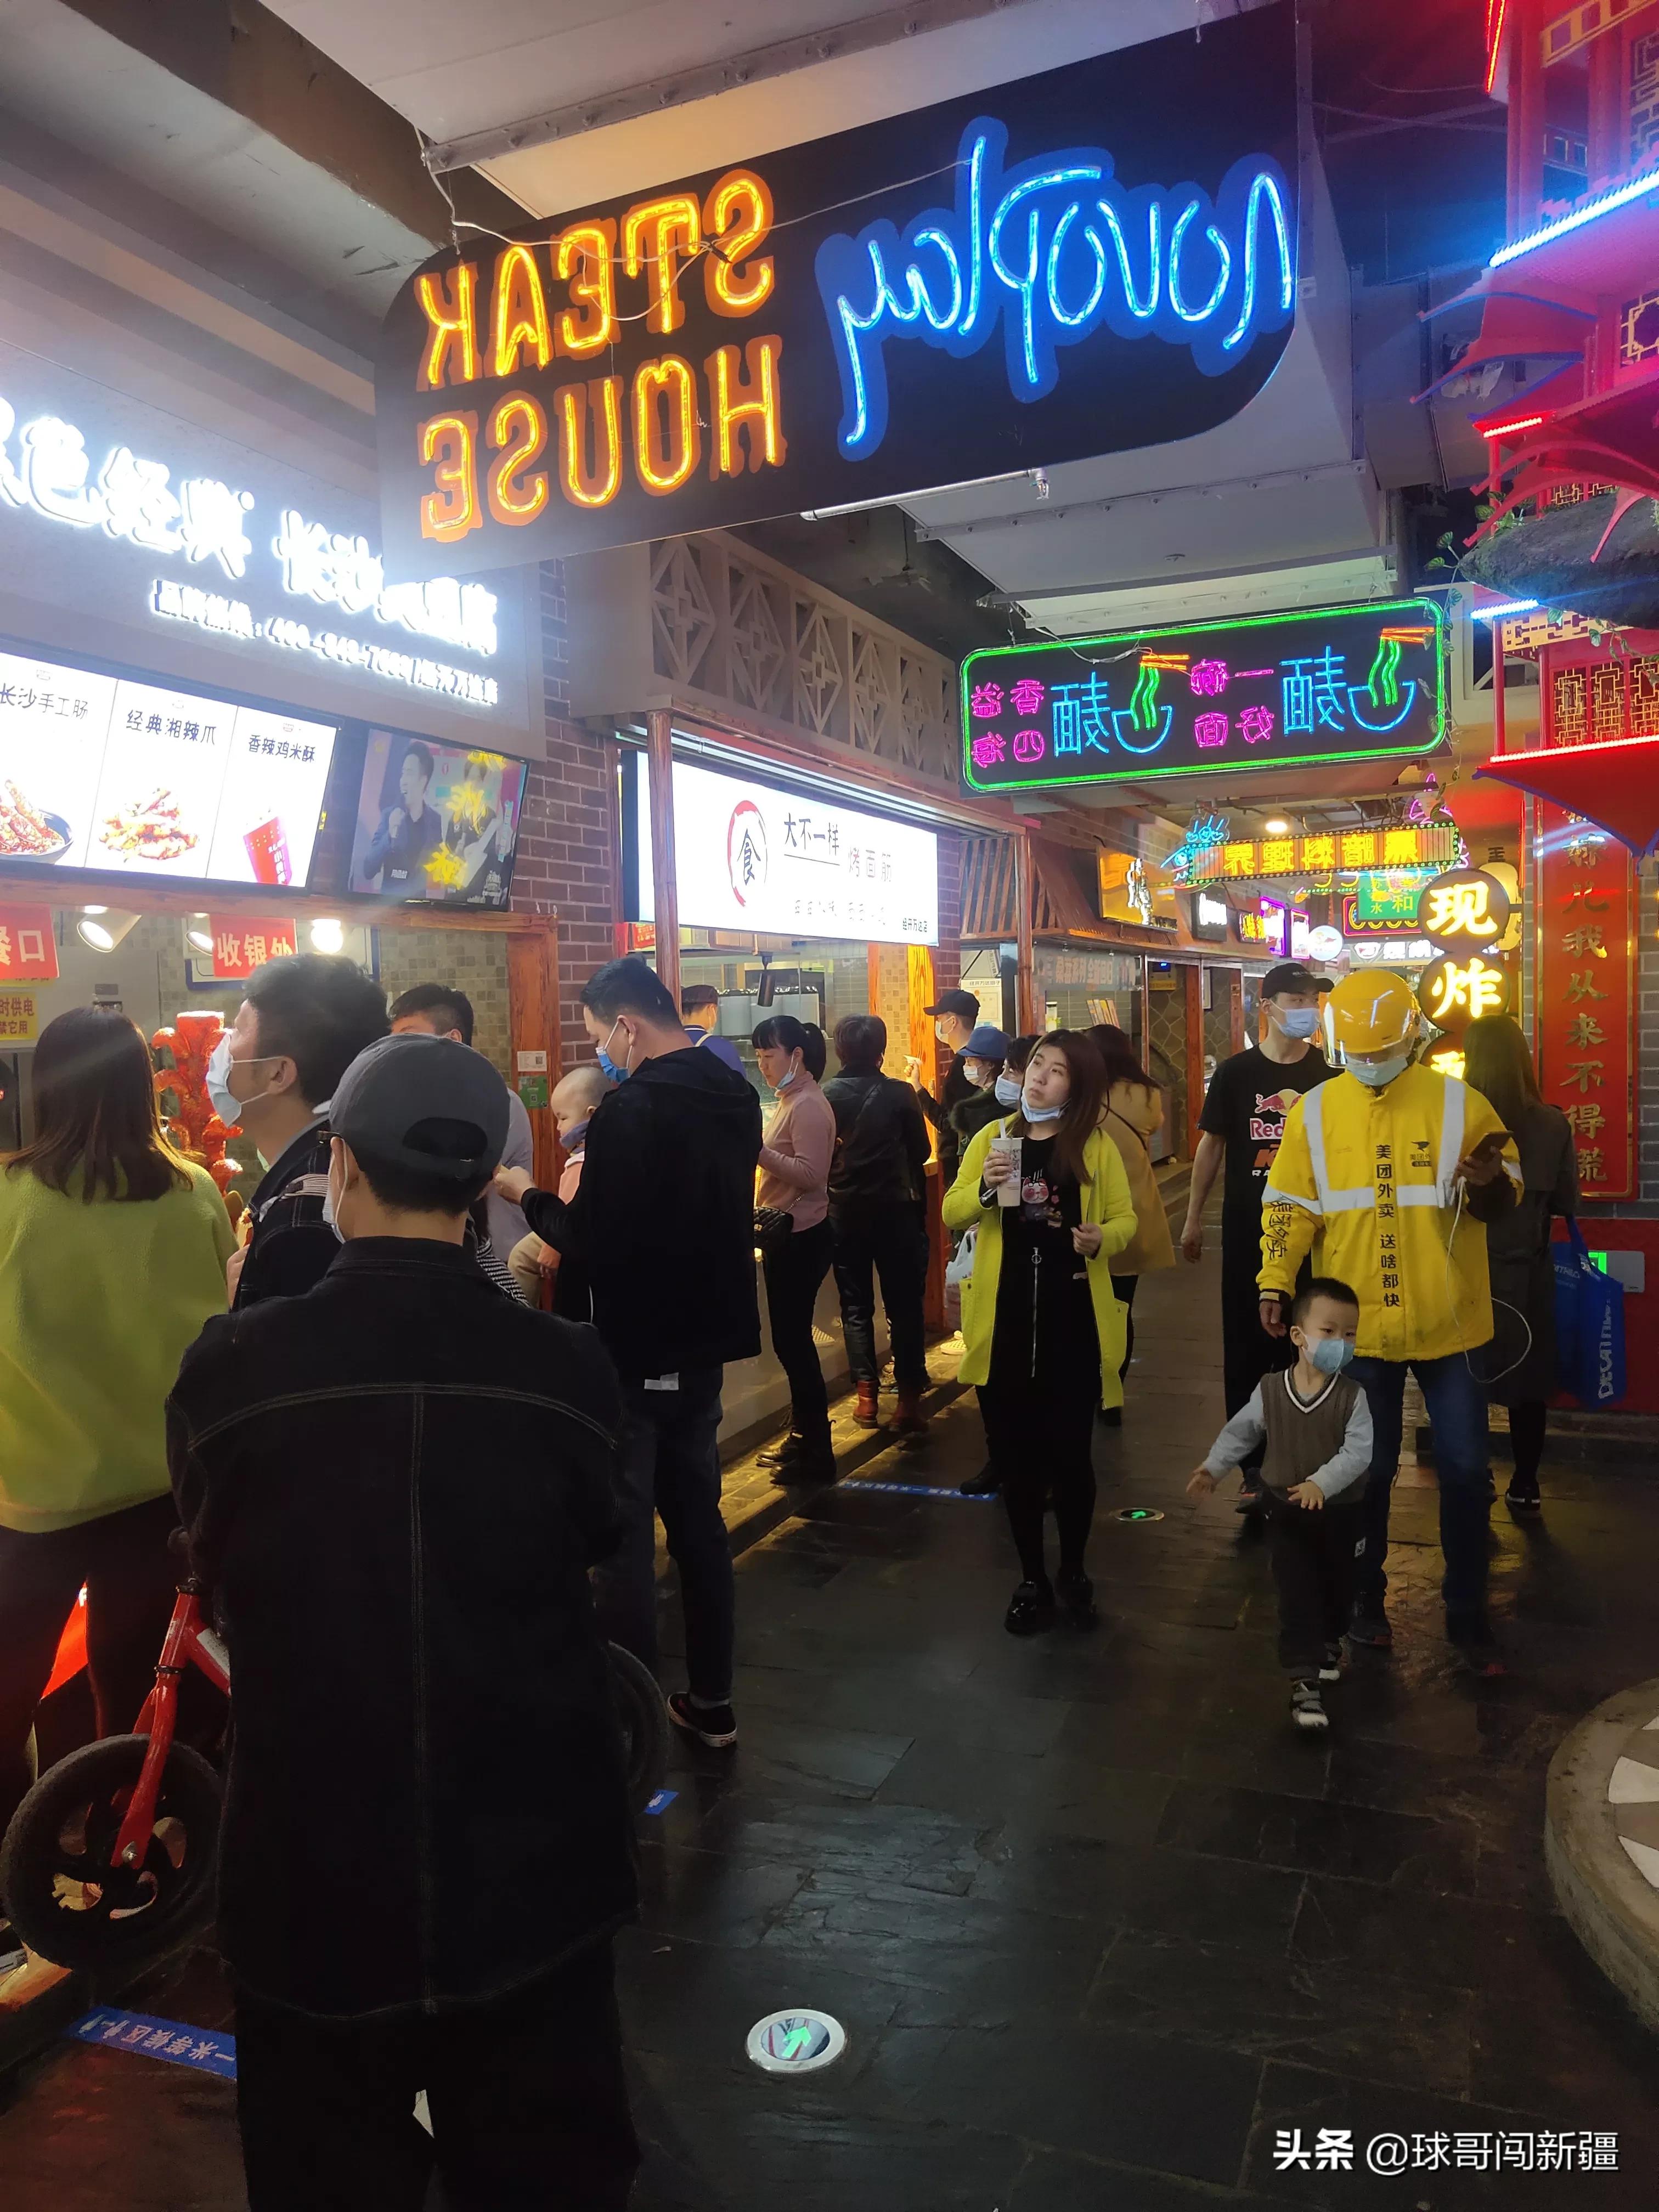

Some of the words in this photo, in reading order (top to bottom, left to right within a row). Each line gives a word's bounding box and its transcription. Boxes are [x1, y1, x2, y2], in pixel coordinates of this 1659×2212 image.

[0, 683, 88, 720] 长沙手工肠
[126, 709, 217, 746] 经典湘辣爪
[248, 734, 315, 764] 香辣鸡米酥
[784, 812, 840, 856] 大不一样
[737, 828, 761, 886] 食
[848, 847, 892, 882] 烤面筋
[217, 932, 296, 968] 收银处
[1250, 1118, 1287, 1140] Red
[1254, 1144, 1280, 1167] K
[1374, 1144, 1395, 1220] 美团外卖
[1379, 1233, 1401, 1308] 送啥都快
[120, 2024, 236, 2061] 一米等候区
